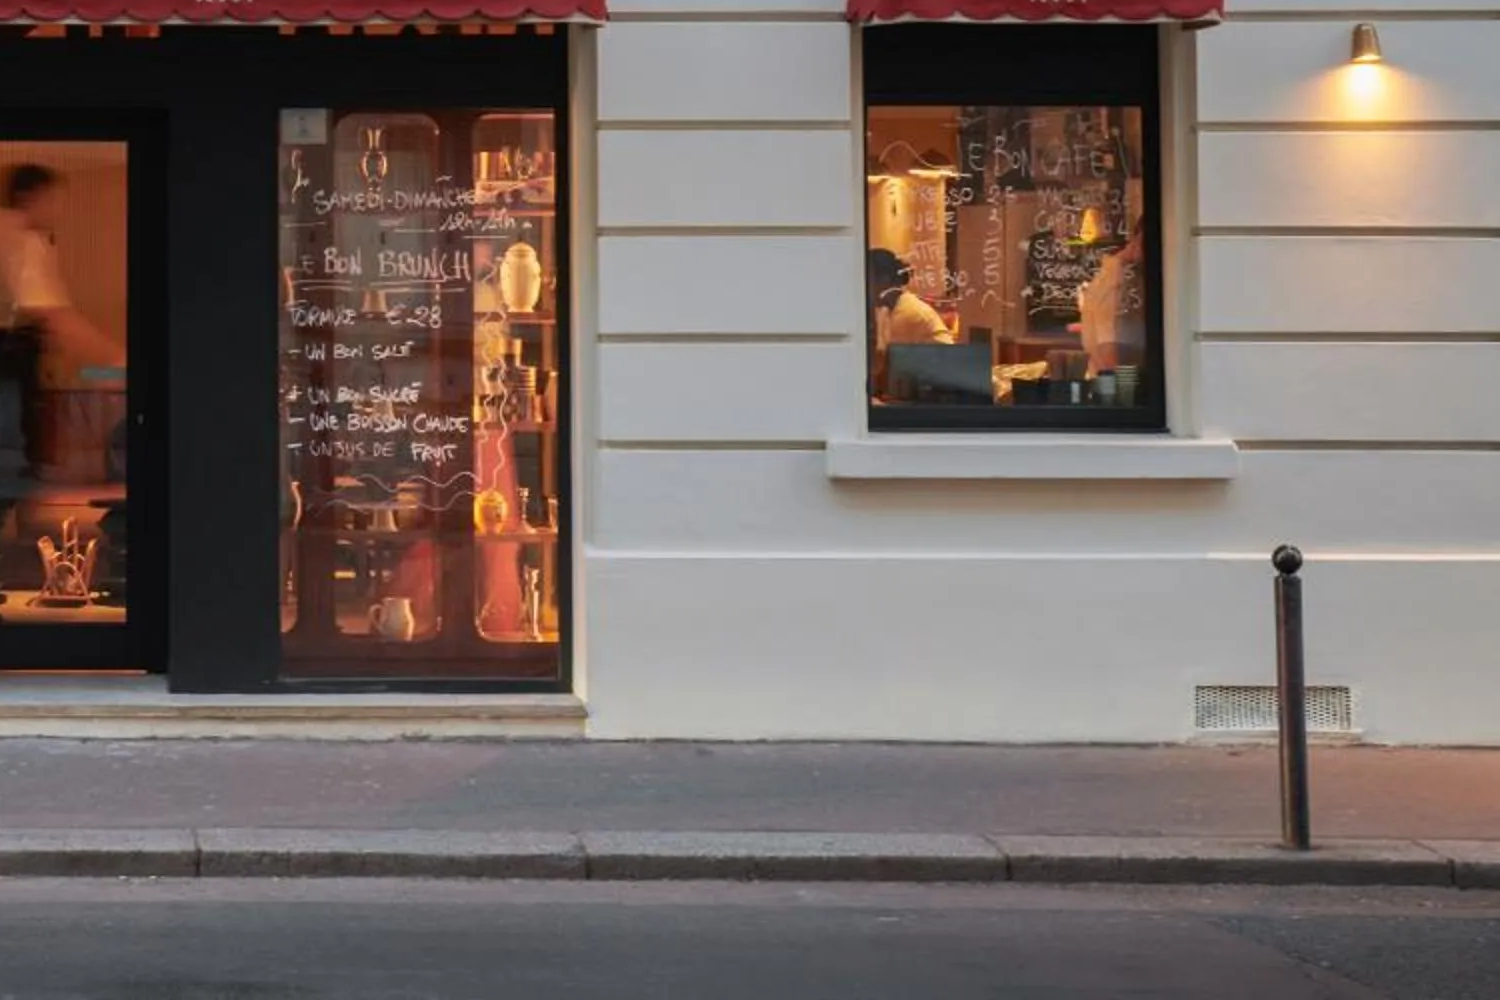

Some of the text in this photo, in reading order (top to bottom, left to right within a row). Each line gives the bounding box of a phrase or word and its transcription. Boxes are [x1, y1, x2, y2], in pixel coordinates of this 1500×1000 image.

[323, 247, 362, 275] BON
[379, 249, 472, 281] BRUNCH
[305, 343, 325, 361] UN
[309, 413, 340, 431] UNE
[373, 440, 396, 458] DE
